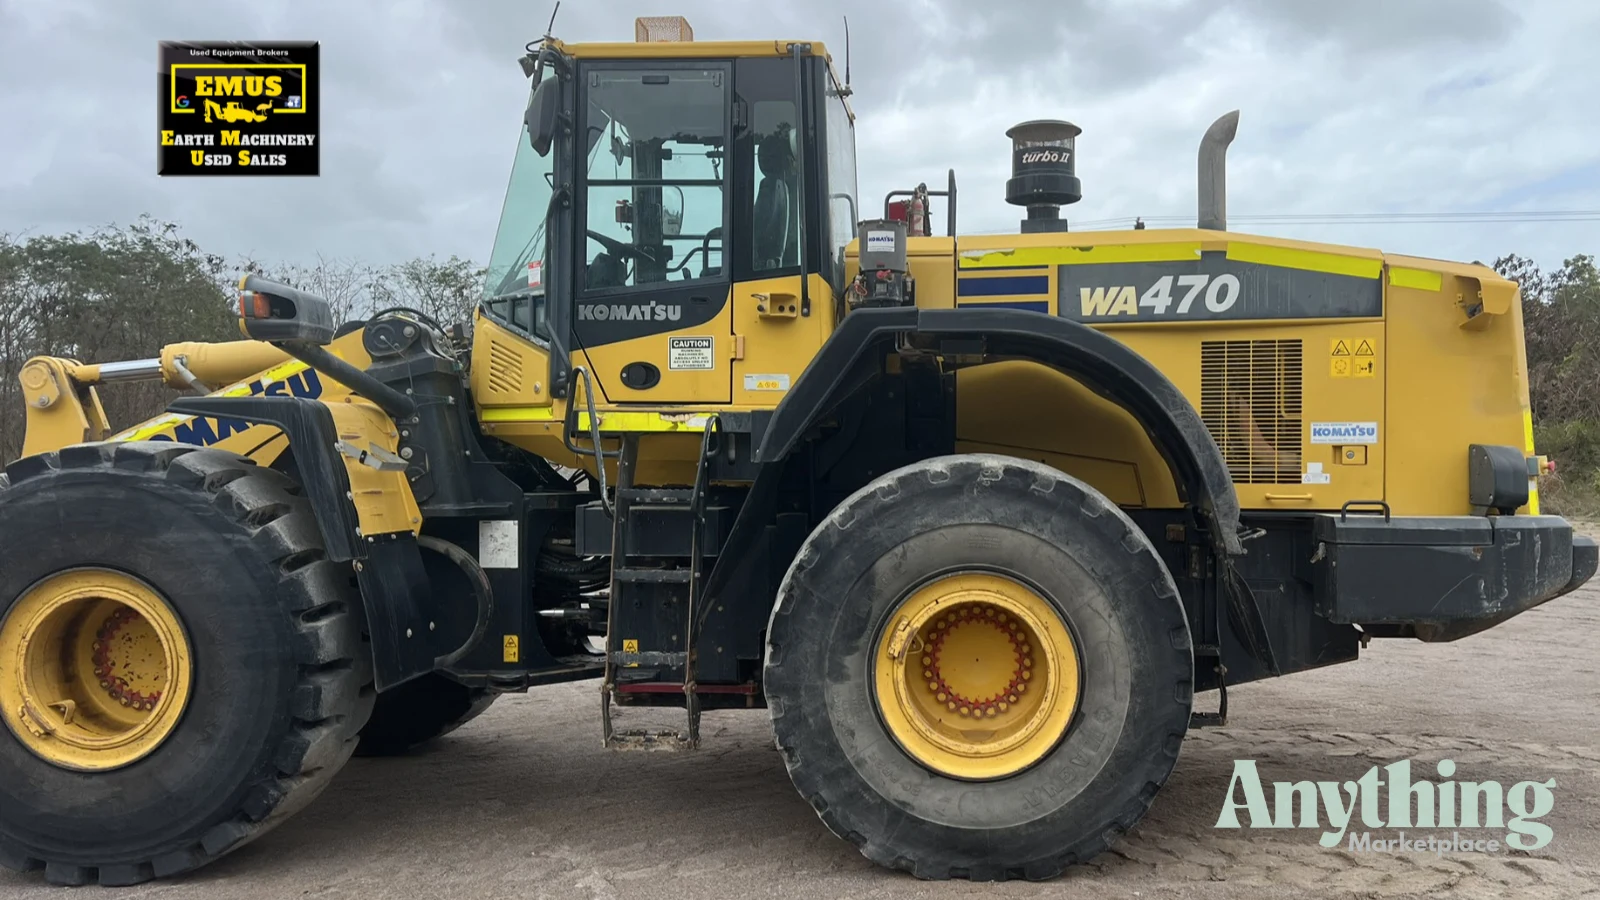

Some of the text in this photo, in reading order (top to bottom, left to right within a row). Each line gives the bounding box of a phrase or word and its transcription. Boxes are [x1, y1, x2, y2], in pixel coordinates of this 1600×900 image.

[1022, 150, 1059, 164] turbo
[1079, 273, 1240, 316] WA470
[578, 301, 681, 321] KOMATSU
[673, 340, 709, 348] CAUTION
[1312, 424, 1375, 437] KOMATSU
